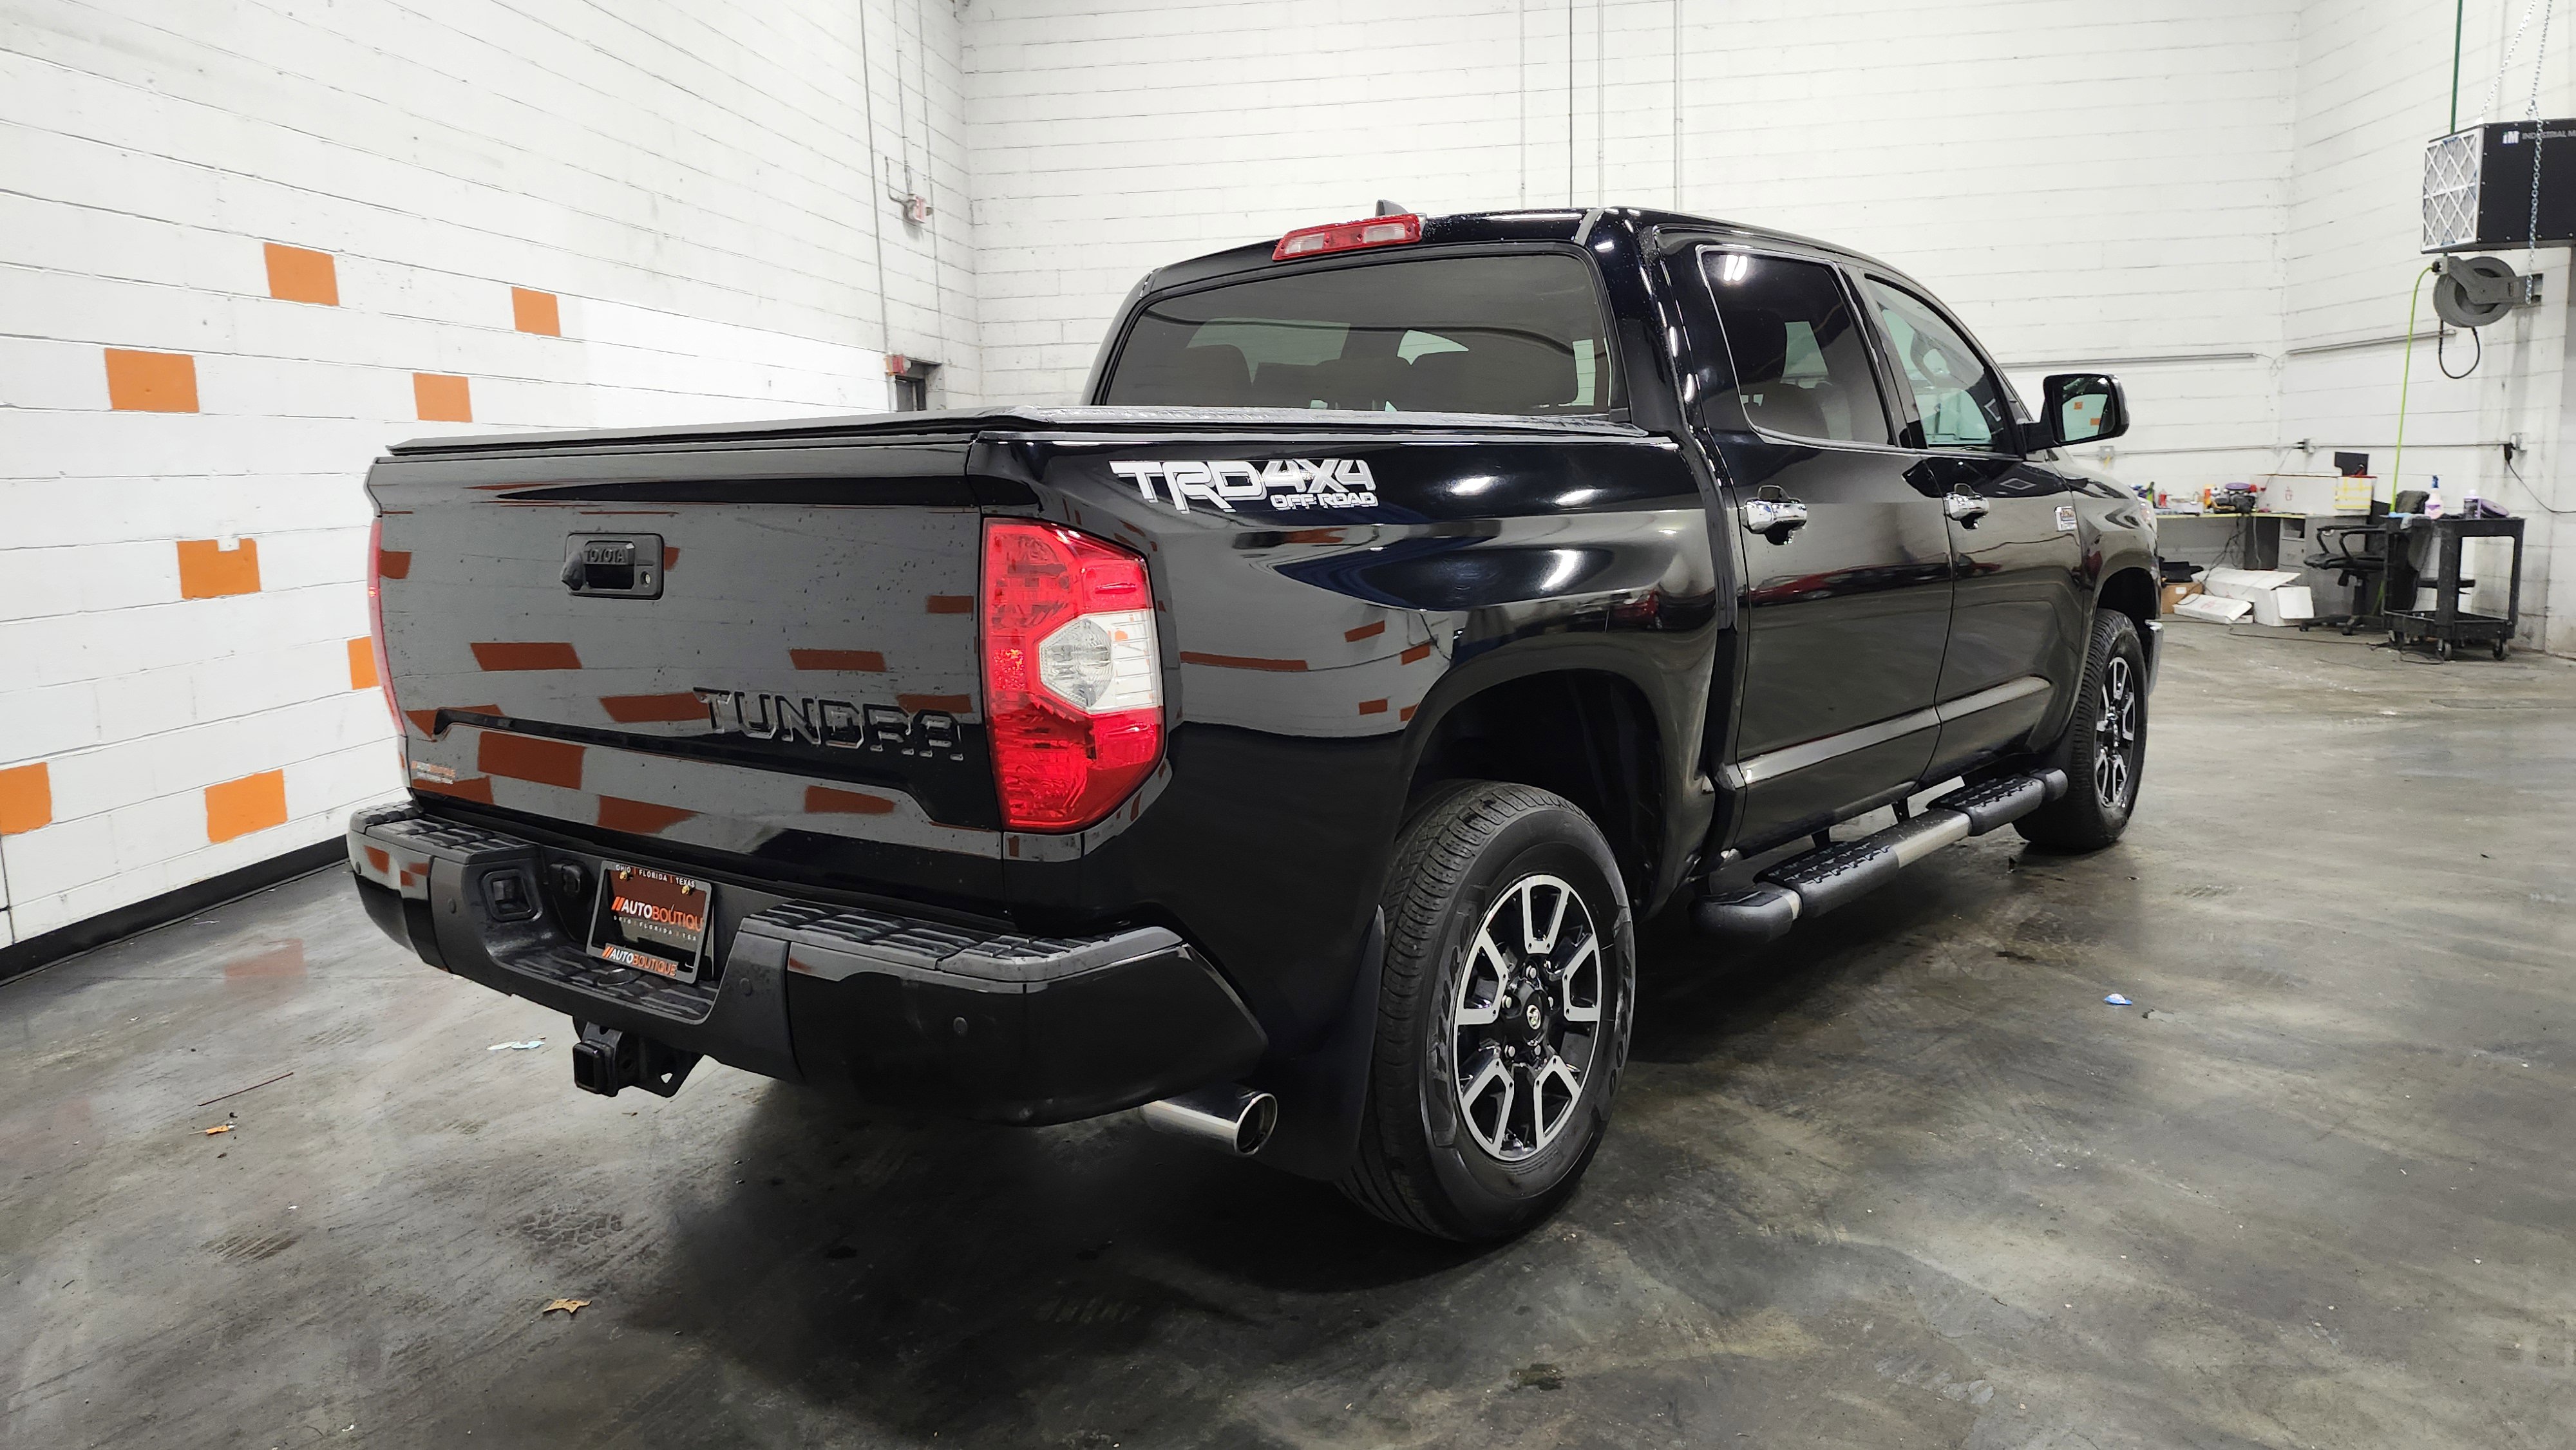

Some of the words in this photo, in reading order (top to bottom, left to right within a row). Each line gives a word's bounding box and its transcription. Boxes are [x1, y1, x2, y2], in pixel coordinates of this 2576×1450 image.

[2522, 131, 2567, 139] INDSTRIAL
[1108, 460, 1267, 514] TRD
[1270, 493, 1318, 511] OFF
[1317, 492, 1379, 509] ROAD
[583, 548, 626, 563] TOYOTA
[693, 686, 964, 761] TUNDRA
[616, 864, 631, 874] OHIO
[639, 869, 667, 881] FLORIDA
[676, 877, 695, 888] TEXAS
[621, 899, 703, 932] AUTOBOUTIQU
[639, 921, 672, 935] FLORIDA
